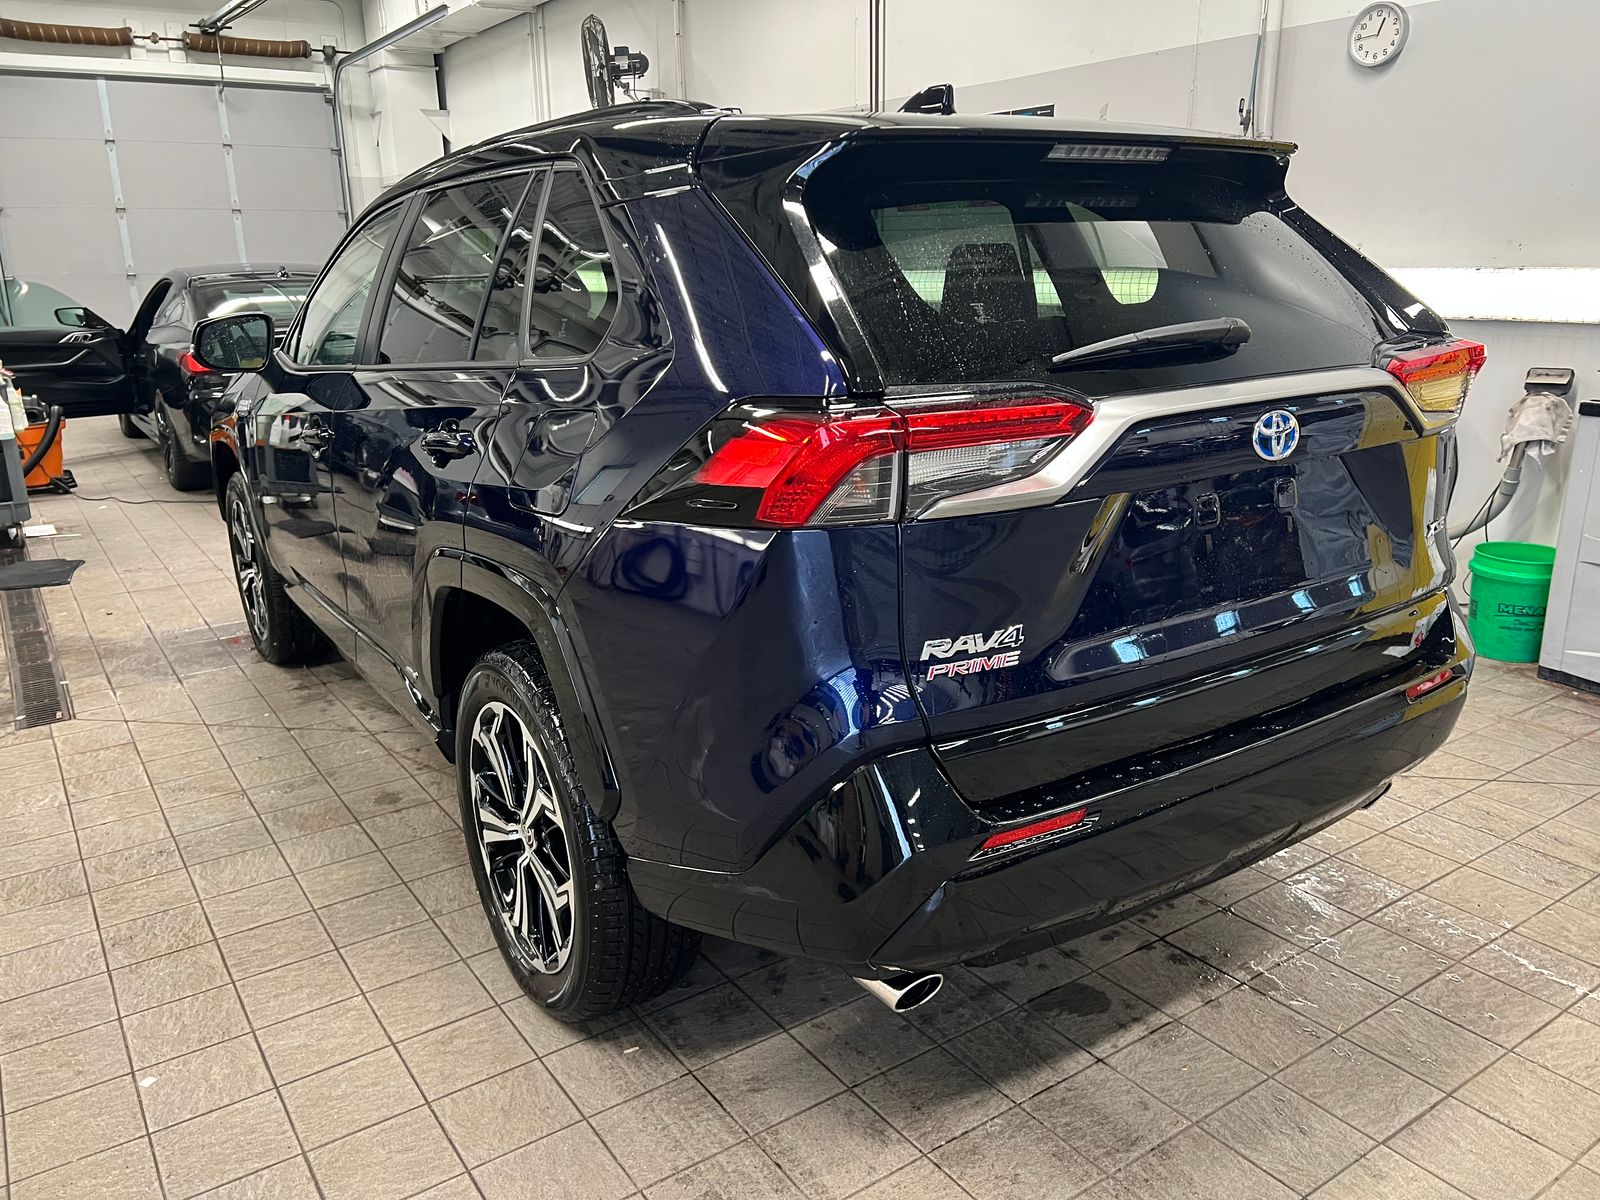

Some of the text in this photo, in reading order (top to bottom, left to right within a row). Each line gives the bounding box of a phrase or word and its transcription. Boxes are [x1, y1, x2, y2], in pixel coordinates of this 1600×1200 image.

[1360, 23, 1368, 31] 10
[1390, 39, 1395, 47] 4
[1364, 50, 1369, 58] 7
[1372, 52, 1378, 60] 6
[1382, 48, 1388, 56] 5
[919, 623, 1025, 662] RAV4
[926, 649, 1022, 682] PRIME
